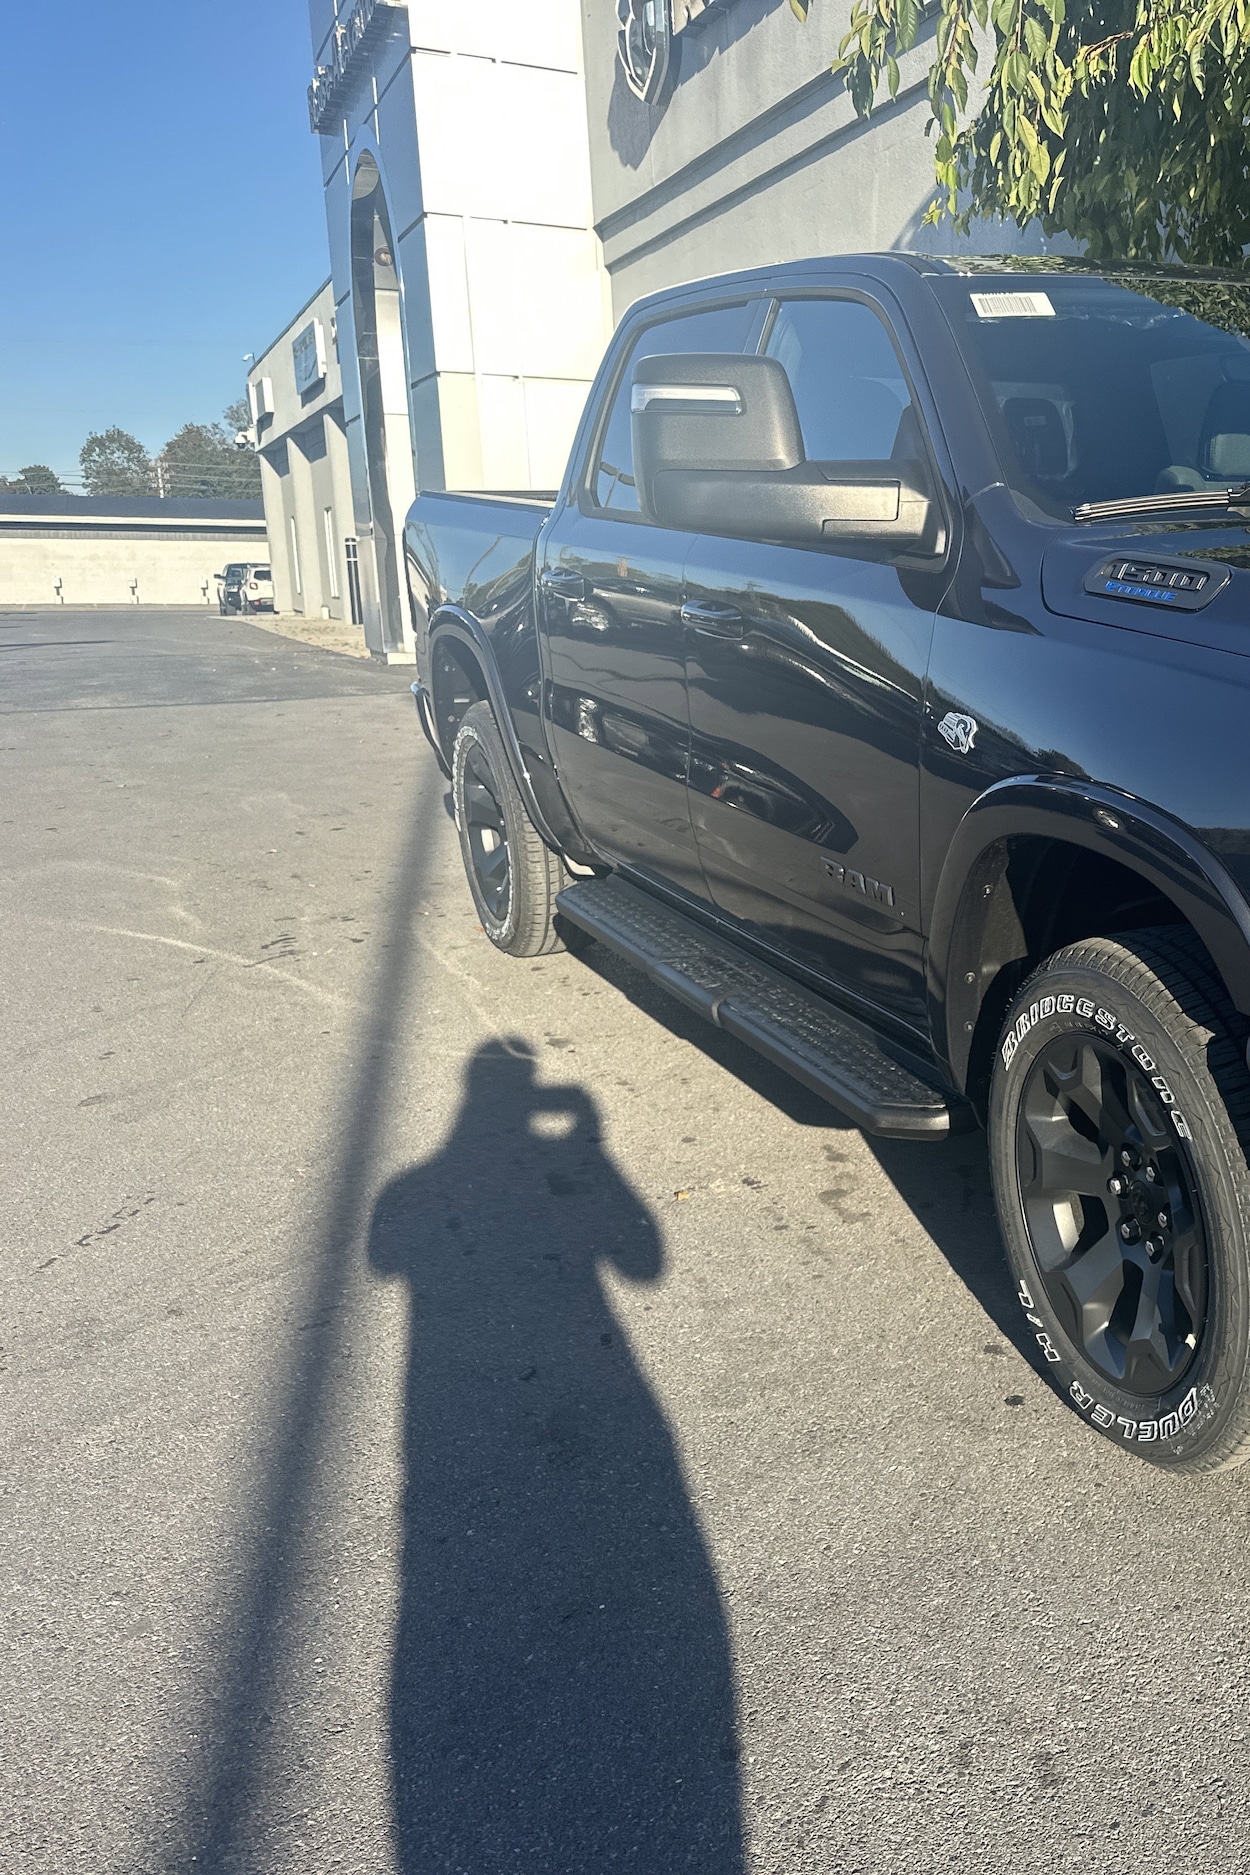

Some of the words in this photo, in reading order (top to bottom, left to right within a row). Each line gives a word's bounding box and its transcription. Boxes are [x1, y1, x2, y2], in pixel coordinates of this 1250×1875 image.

[1109, 552, 1208, 592] 1500
[820, 856, 896, 907] RAM
[1001, 994, 1193, 1142] BRIDGESTONE
[1069, 1380, 1199, 1442] DUELER
